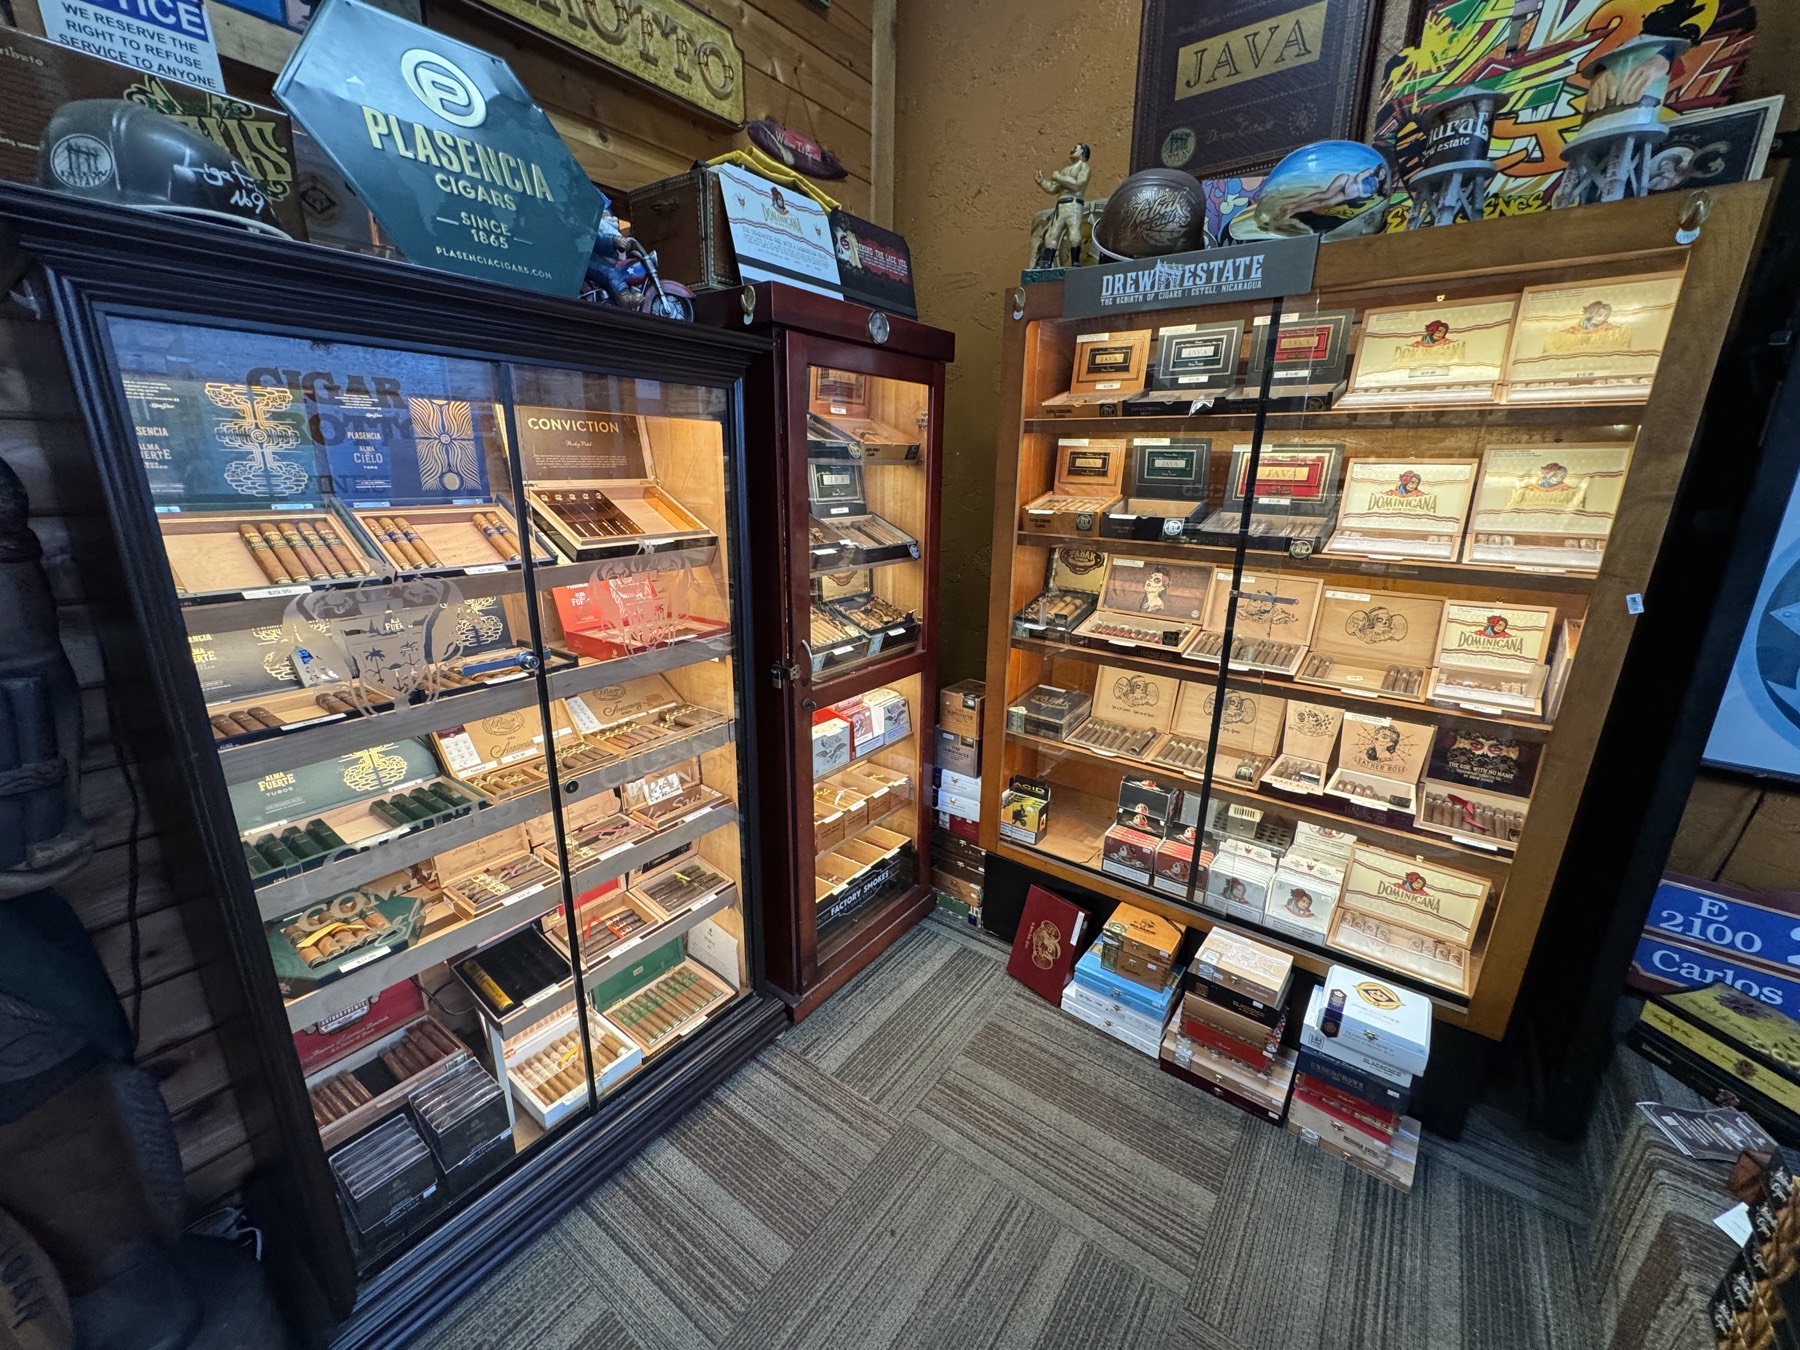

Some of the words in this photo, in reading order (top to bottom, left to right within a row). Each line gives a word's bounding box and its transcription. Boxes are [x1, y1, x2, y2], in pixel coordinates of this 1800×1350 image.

[62, 2, 91, 20] WE
[95, 12, 166, 44] RESERVE
[169, 37, 200, 54] THE
[66, 19, 115, 43] RIGHT
[119, 35, 141, 51] TO
[145, 44, 204, 70] REFUSE
[1185, 19, 1312, 89] JAVA
[59, 33, 129, 63] SERVICE
[131, 55, 153, 71] TO
[157, 63, 216, 89] ANYONE
[361, 104, 555, 203] PLASENCIA
[1437, 136, 1471, 152] estate
[435, 172, 517, 212] CIGARS
[461, 211, 512, 237] SINCE
[471, 229, 509, 250] 1865
[436, 245, 553, 280] PLASENCIACIGARS.COM
[875, 249, 885, 259] THE
[885, 253, 897, 263] LACE
[1101, 268, 1155, 297] DREW
[1184, 254, 1266, 287] ESTATE
[1101, 297, 1113, 306] THE
[1116, 294, 1144, 305] REBIRTH
[1147, 292, 1157, 302] OF
[1158, 289, 1183, 300] CIGARS
[1221, 280, 1263, 293] NICARAGUA
[1187, 348, 1209, 357] JAVA
[1288, 339, 1311, 347] JAVA
[246, 366, 410, 410] CIGAR
[135, 426, 169, 438] SENCIA
[347, 431, 382, 441] PLASENCIA
[527, 416, 620, 434] CONVICTION
[353, 452, 384, 464] CIELO
[1265, 469, 1298, 479] JAVA
[1367, 493, 1438, 513] DOMINICANA
[1458, 632, 1525, 655] DOMINICANA
[1353, 757, 1384, 771] LEATHER
[1387, 764, 1407, 773] ROSE
[1473, 766, 1488, 774] WITH
[1488, 768, 1497, 776] NO
[1498, 771, 1515, 780] NAME
[258, 773, 296, 792] FUERTE
[265, 771, 286, 783] ALMA
[1012, 781, 1045, 794] ACID
[265, 786, 295, 798] TUBOS
[830, 890, 862, 916] FACTORY
[863, 870, 890, 893] SMOKES
[1377, 880, 1441, 914] DOMINICANA
[1695, 896, 1729, 922] E
[1659, 910, 1762, 953] 2100
[1652, 950, 1784, 1005] Carlos
